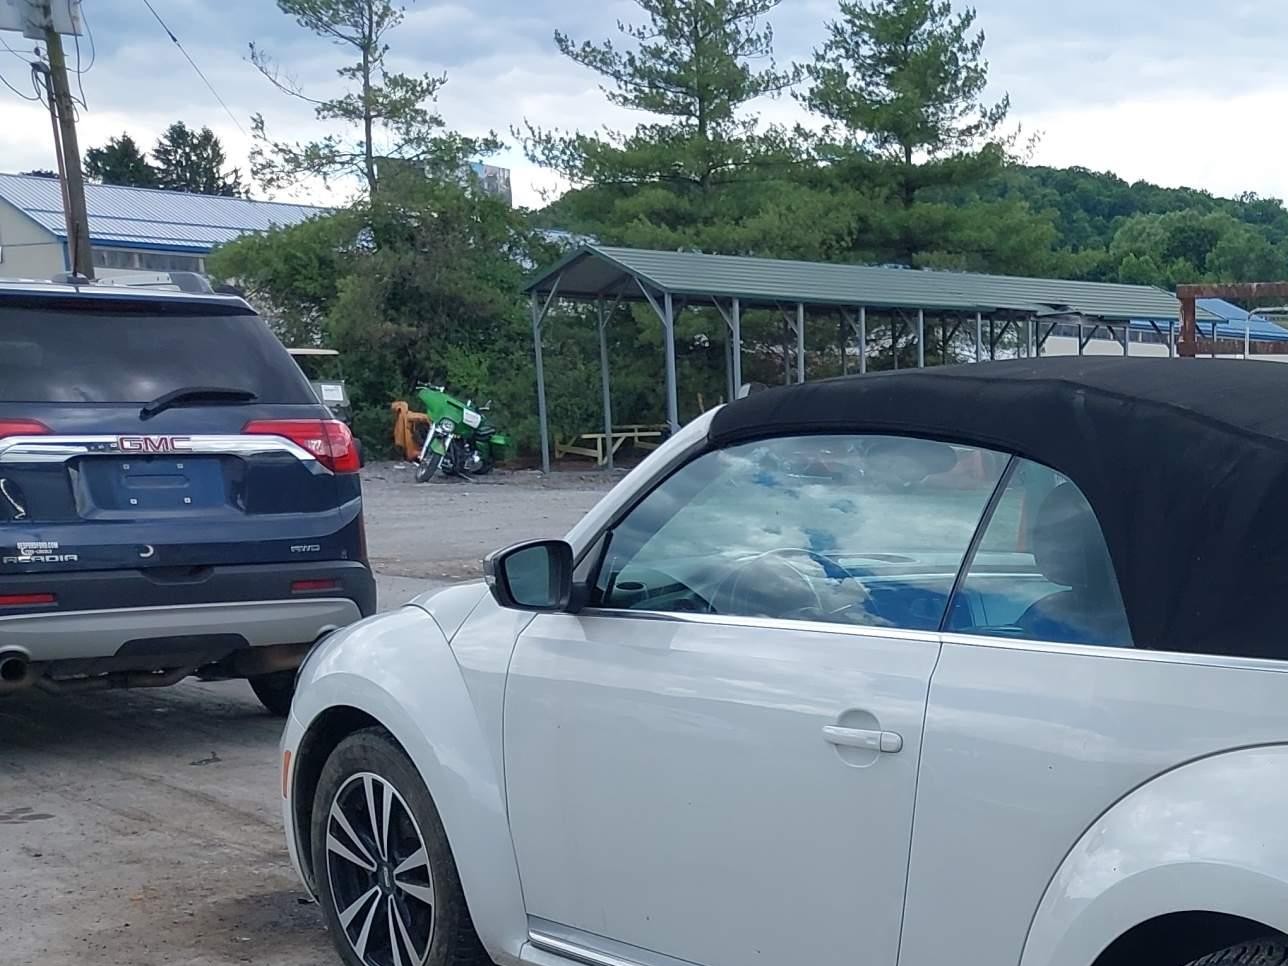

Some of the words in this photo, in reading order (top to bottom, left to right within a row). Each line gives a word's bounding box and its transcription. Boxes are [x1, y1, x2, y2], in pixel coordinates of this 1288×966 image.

[119, 436, 193, 453] GMC
[290, 544, 321, 553] AWD
[3, 554, 78, 564] ACADIA
